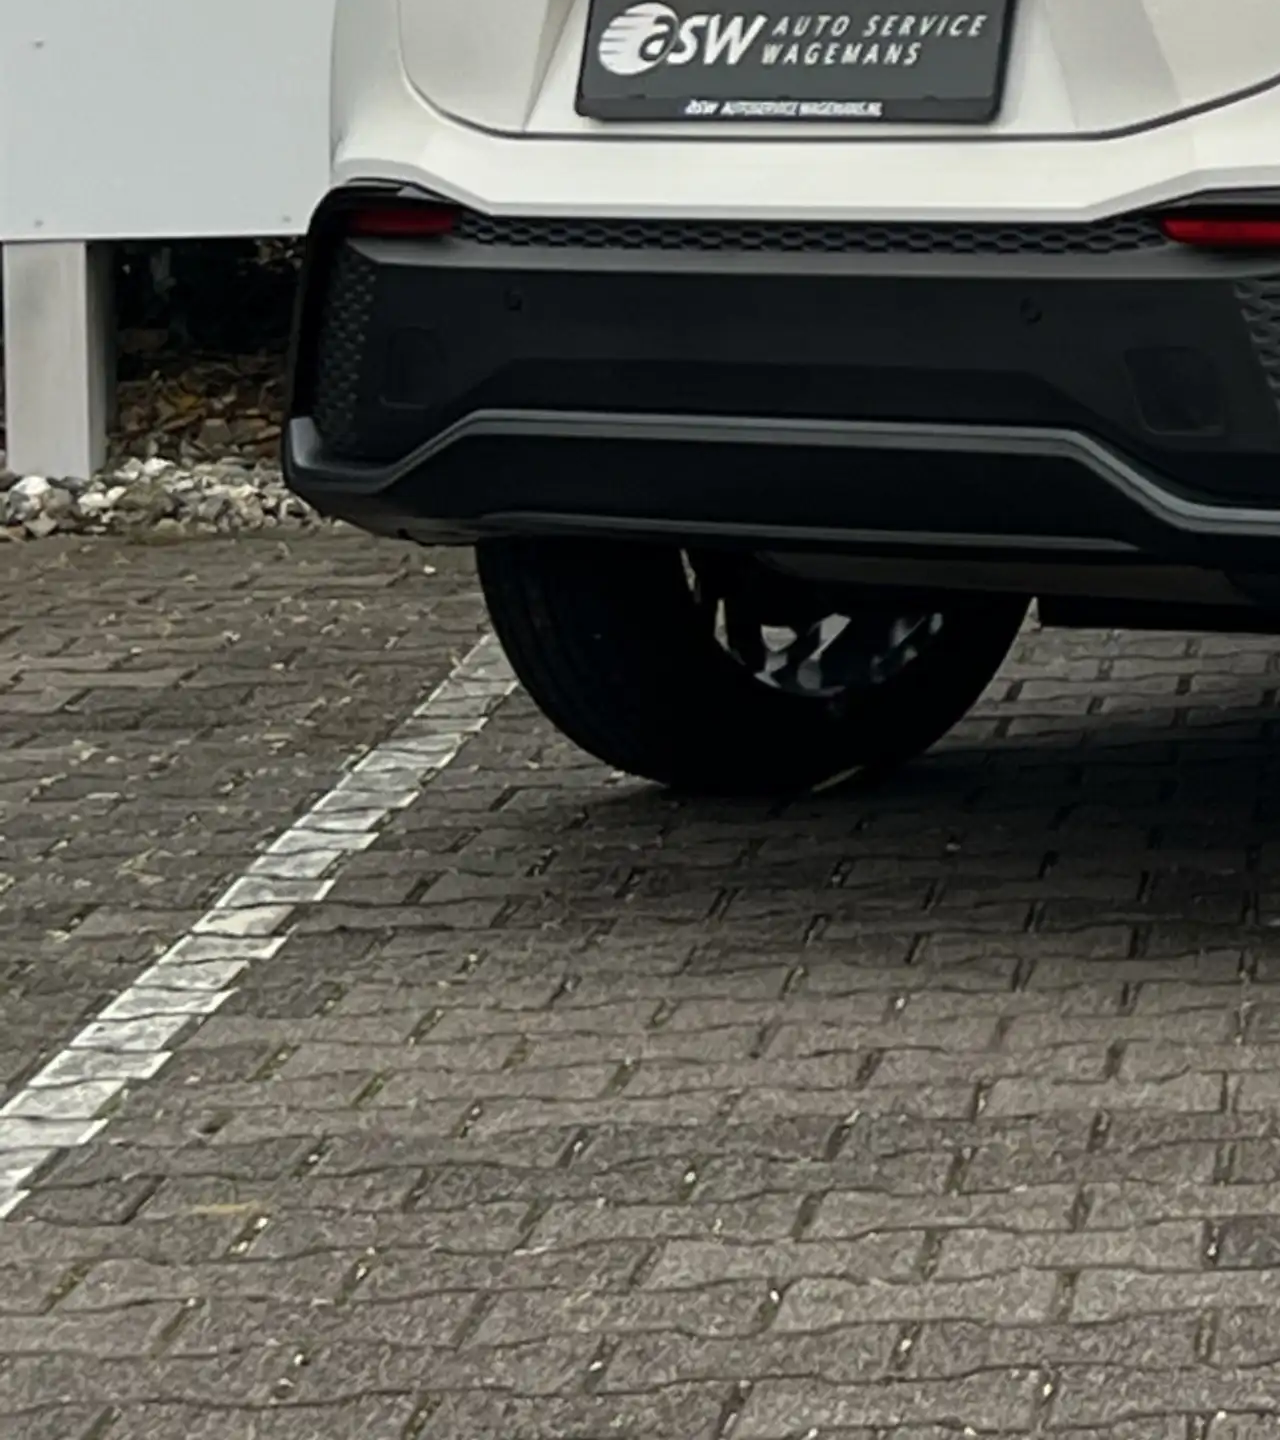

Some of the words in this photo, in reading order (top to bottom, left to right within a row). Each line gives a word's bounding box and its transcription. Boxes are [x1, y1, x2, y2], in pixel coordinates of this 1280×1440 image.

[771, 14, 851, 37] AUTO
[862, 13, 988, 38] SERVICE
[761, 42, 922, 67] WAGEMANS
